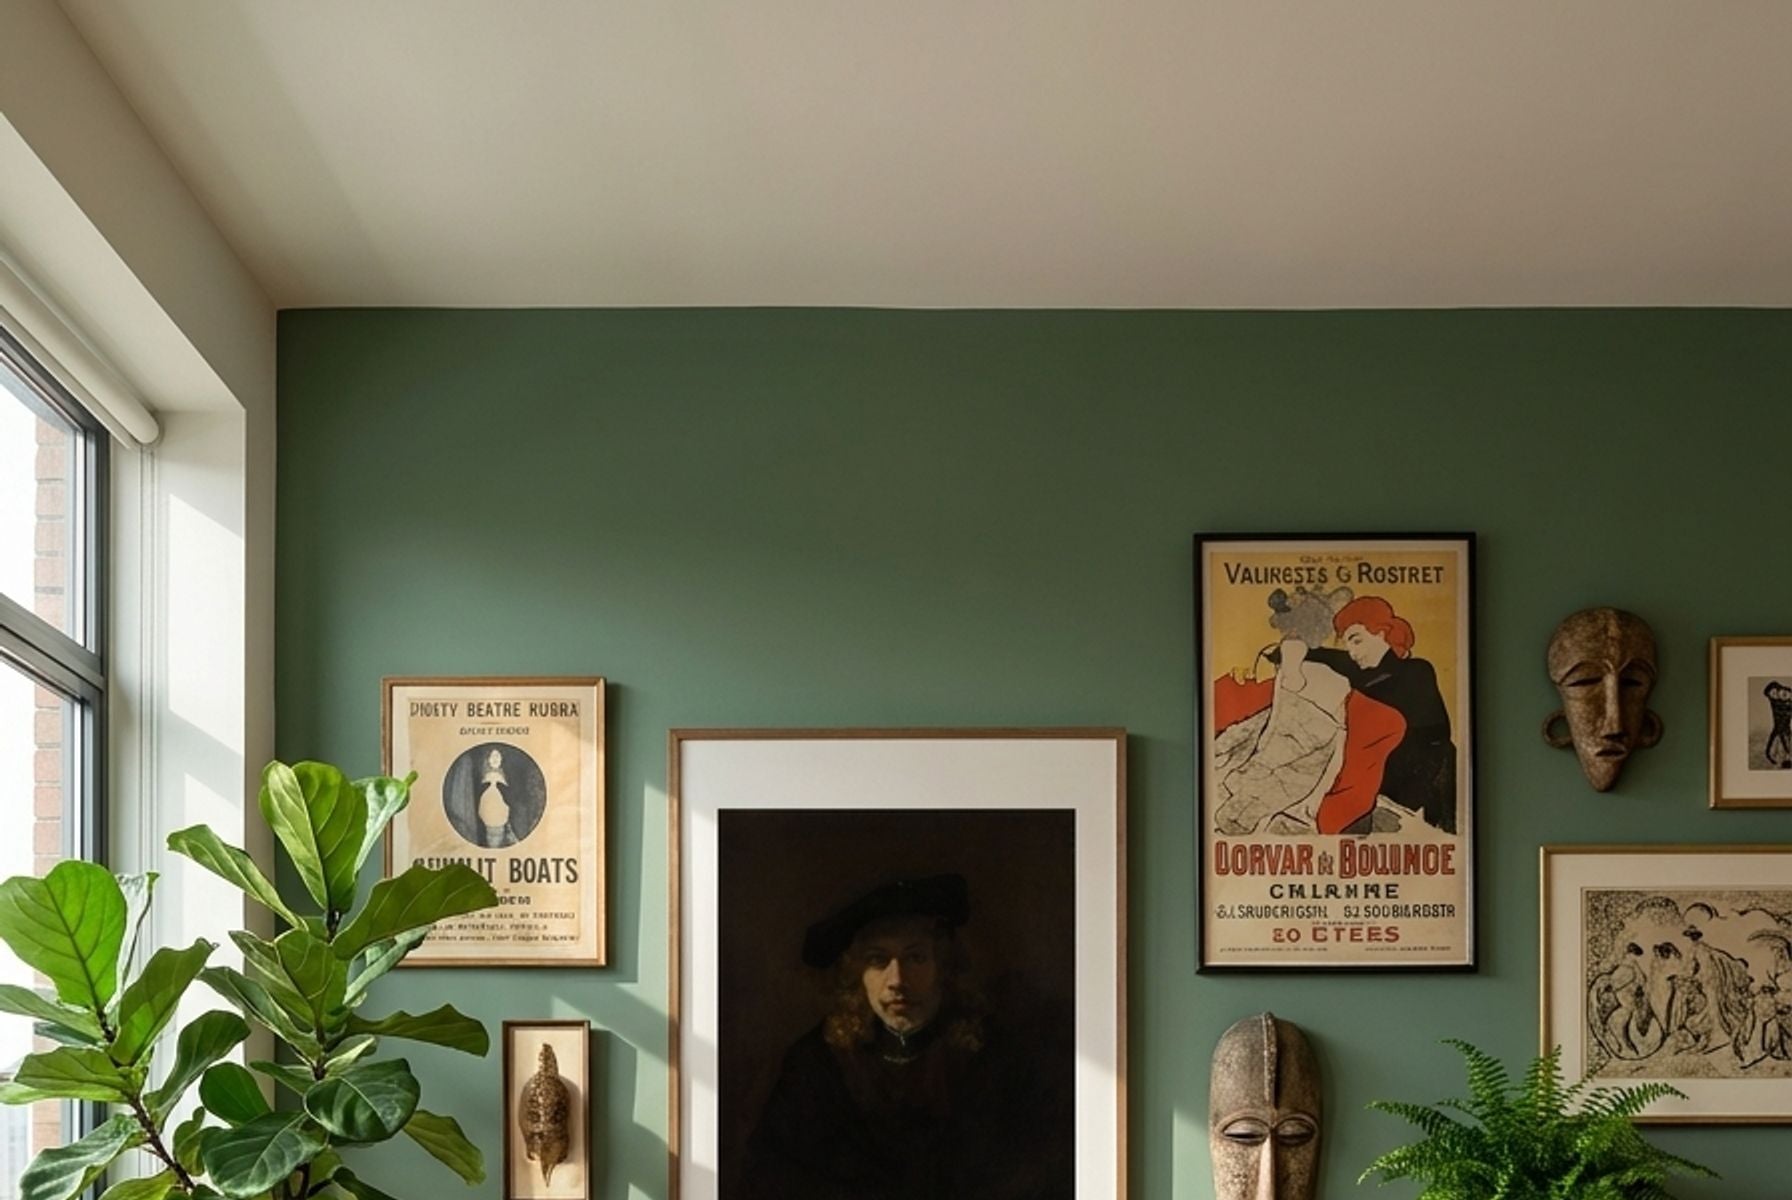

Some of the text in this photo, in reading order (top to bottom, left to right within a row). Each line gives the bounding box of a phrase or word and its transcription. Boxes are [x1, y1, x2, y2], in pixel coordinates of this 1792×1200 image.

[1358, 562, 1444, 584] ROSTRET
[467, 702, 521, 717] BEATRE
[509, 858, 578, 883] BOATS
